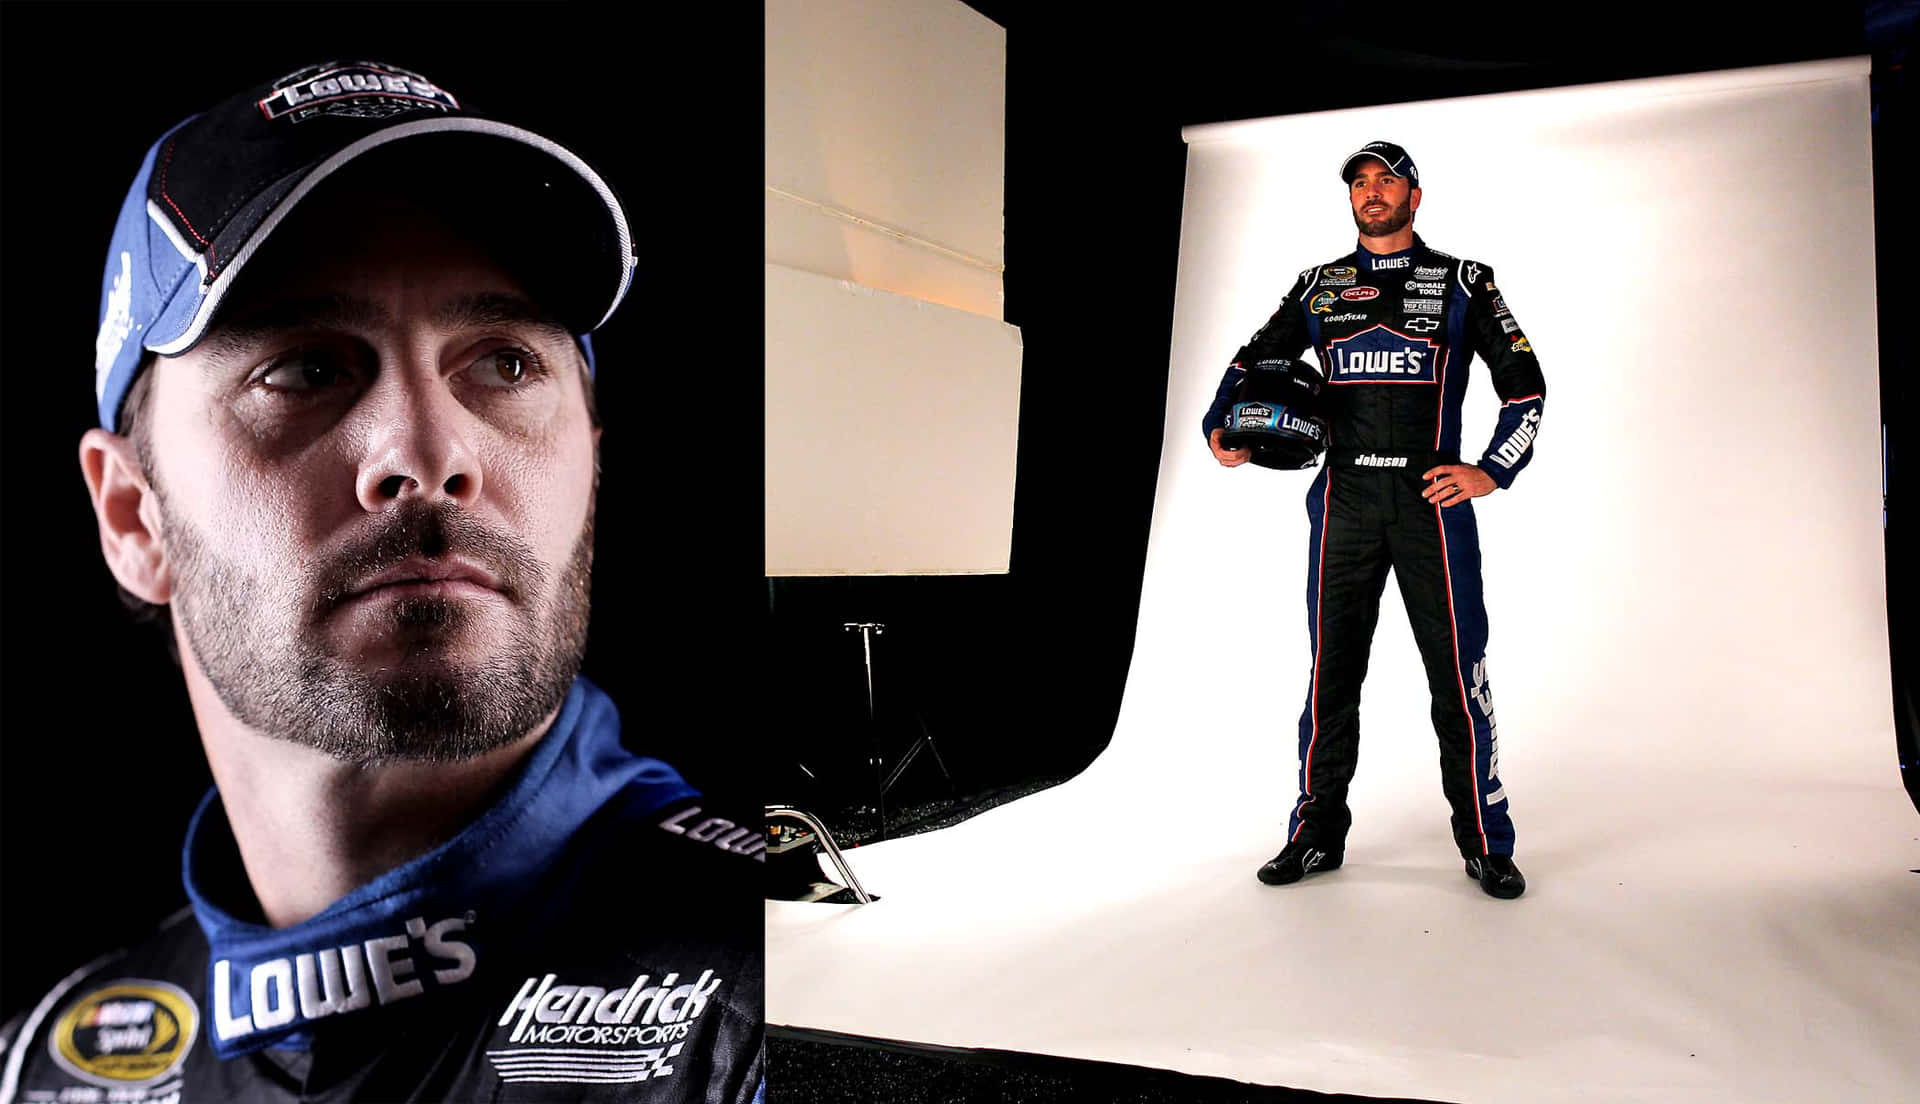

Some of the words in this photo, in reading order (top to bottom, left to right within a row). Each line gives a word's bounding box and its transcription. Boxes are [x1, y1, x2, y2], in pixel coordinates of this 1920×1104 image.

[1371, 256, 1411, 271] LOWE'S
[1418, 288, 1444, 296] TOOLS
[1338, 346, 1424, 375] LOWE'S
[1241, 407, 1271, 417] LOWE'S
[1282, 413, 1321, 440] LOWE'S
[1488, 407, 1540, 469] LOWE'S
[1354, 453, 1408, 468] Johnson
[214, 916, 477, 1041] LOWE'S
[498, 969, 722, 1043] Hendrick
[521, 1020, 693, 1044] MOTORSPORTS
